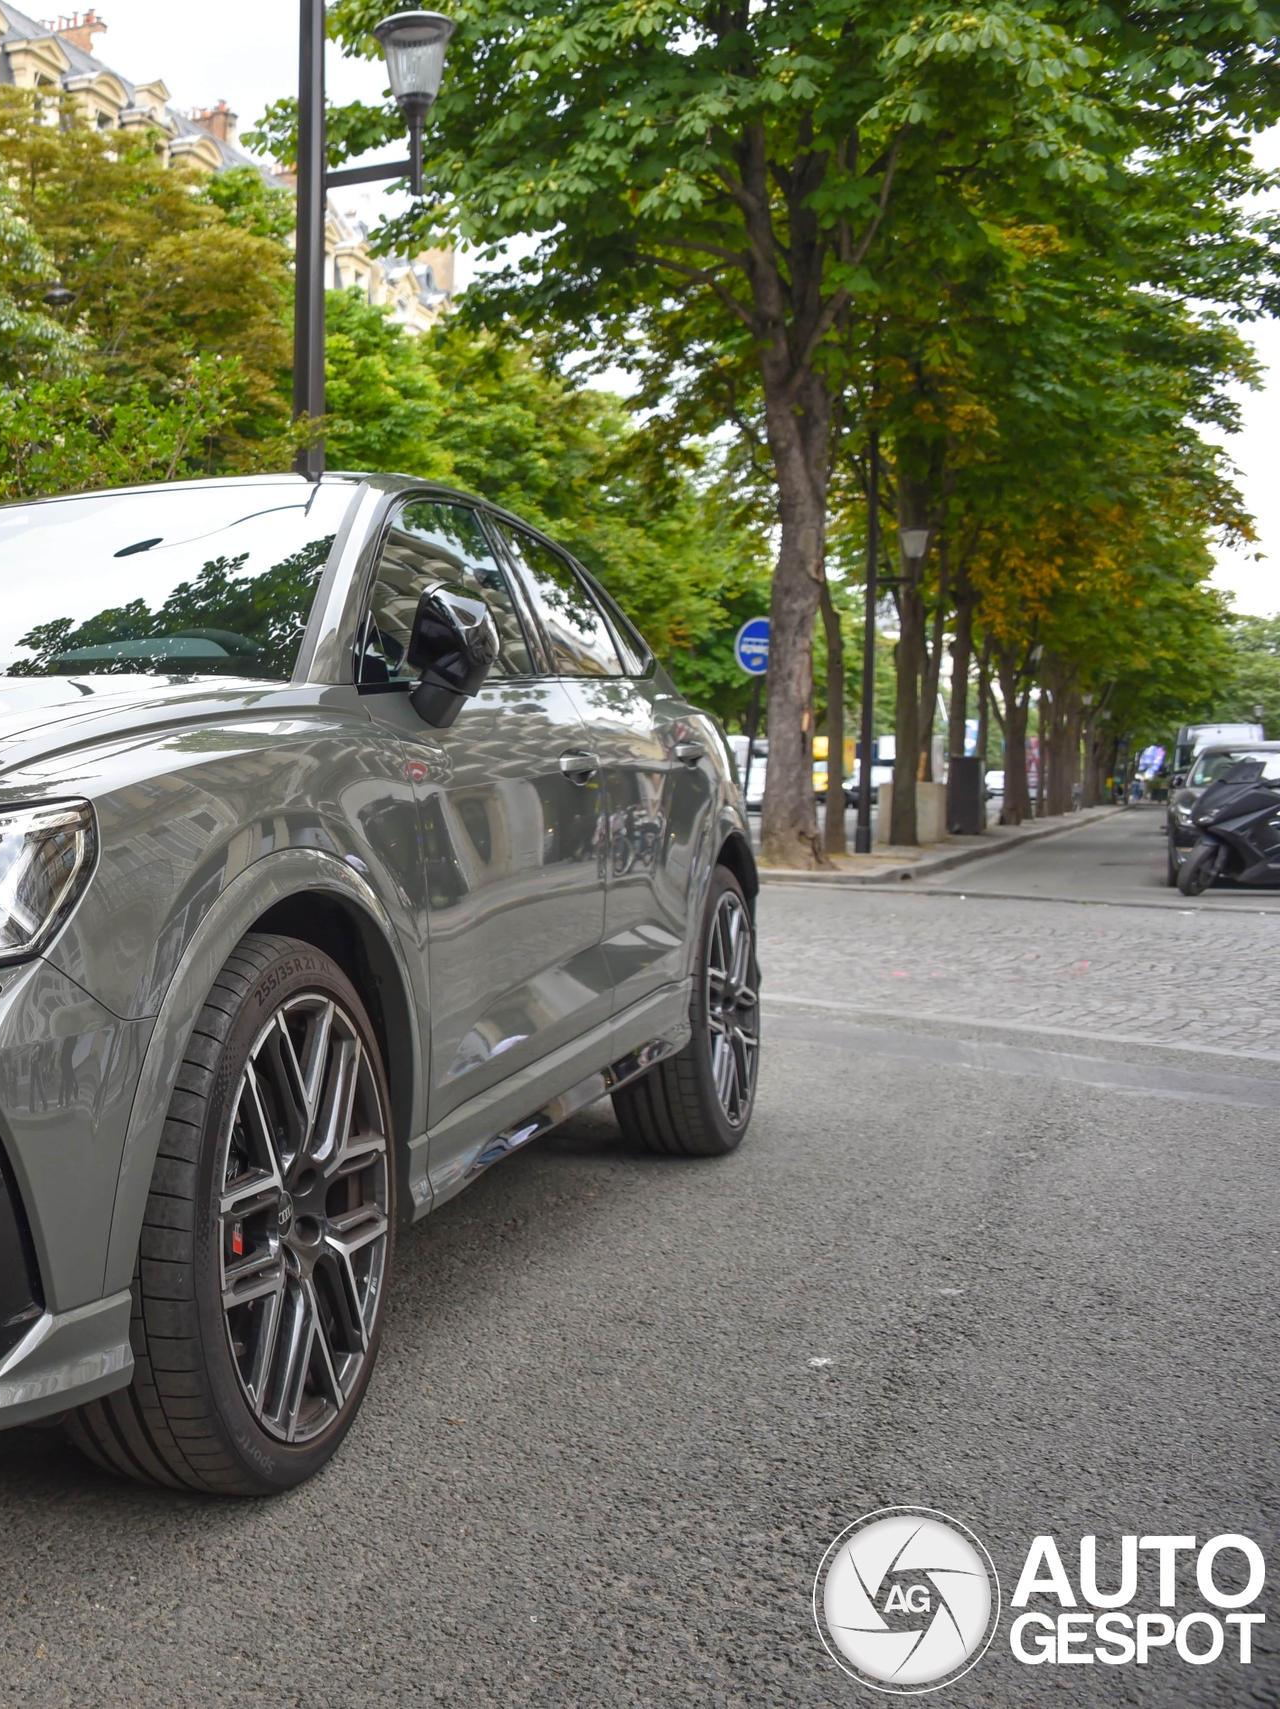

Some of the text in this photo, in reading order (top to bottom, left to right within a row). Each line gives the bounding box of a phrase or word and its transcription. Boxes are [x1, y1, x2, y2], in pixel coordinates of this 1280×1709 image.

[254, 961, 294, 1007] 255/35
[293, 958, 304, 972] R
[304, 956, 317, 971] 21
